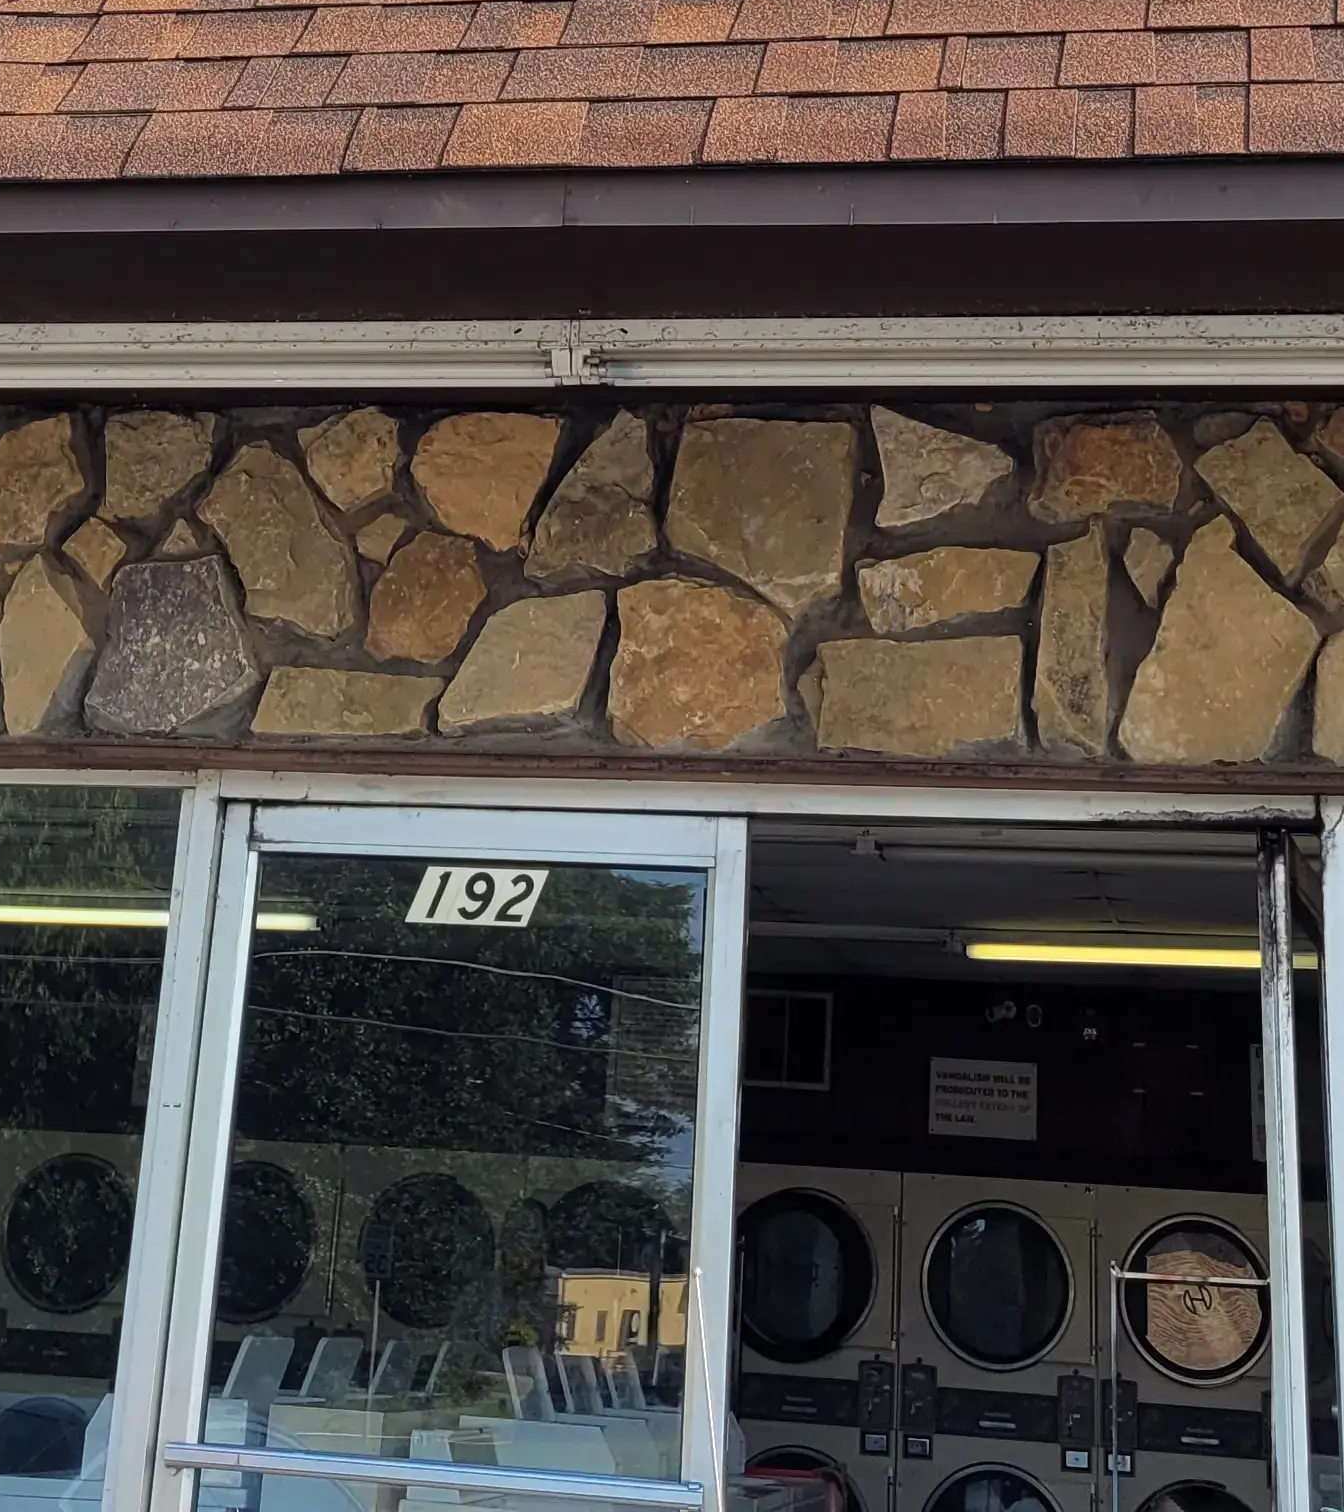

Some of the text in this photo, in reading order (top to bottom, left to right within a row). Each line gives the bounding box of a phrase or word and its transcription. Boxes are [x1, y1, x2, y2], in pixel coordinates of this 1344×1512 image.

[424, 870, 535, 923] 192
[935, 1070, 991, 1082] VANDALISM
[992, 1074, 1016, 1085] WILL
[997, 1088, 1009, 1098] TO
[1011, 1090, 1030, 1099] THE
[935, 1112, 953, 1122] THE
